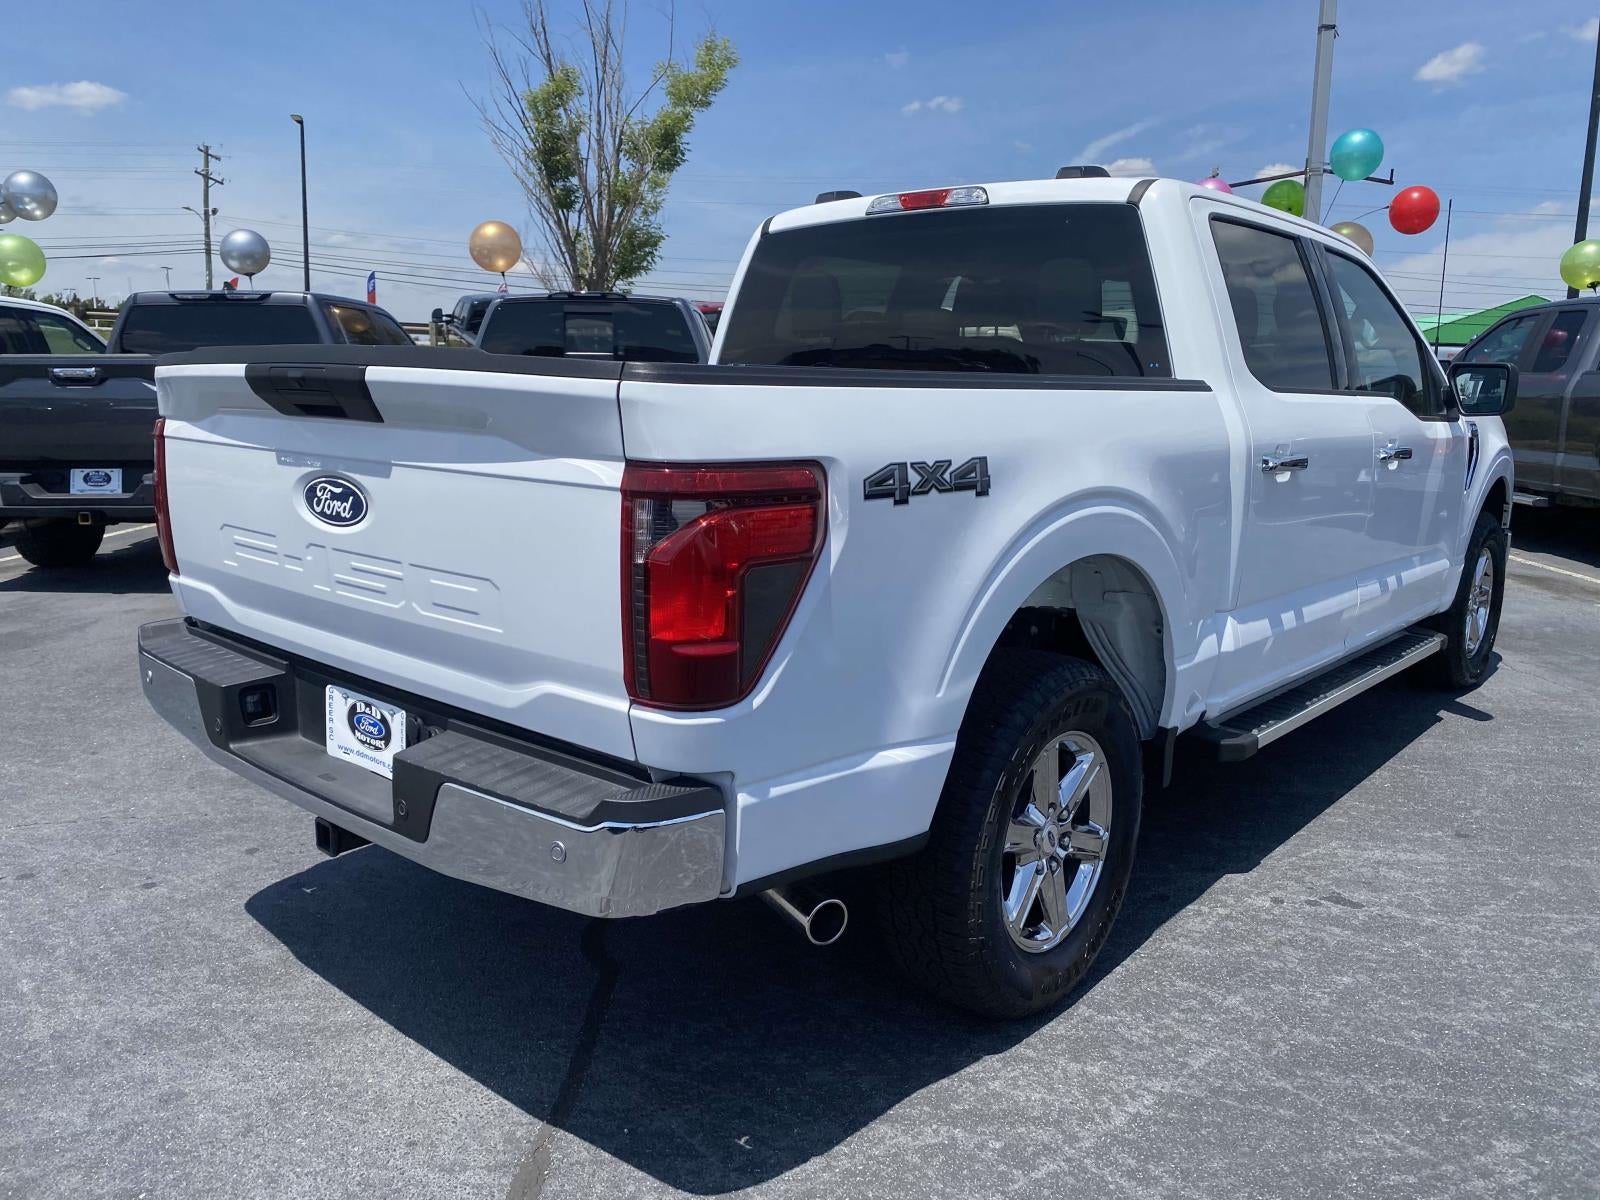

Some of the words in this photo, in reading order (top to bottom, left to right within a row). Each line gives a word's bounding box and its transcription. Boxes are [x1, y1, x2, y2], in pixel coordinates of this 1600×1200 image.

[313, 482, 353, 519] Ford
[356, 701, 381, 720] D&D
[359, 716, 379, 735] Ford
[354, 729, 386, 749] MOTORS
[337, 743, 393, 770] www.ddmotors.c
